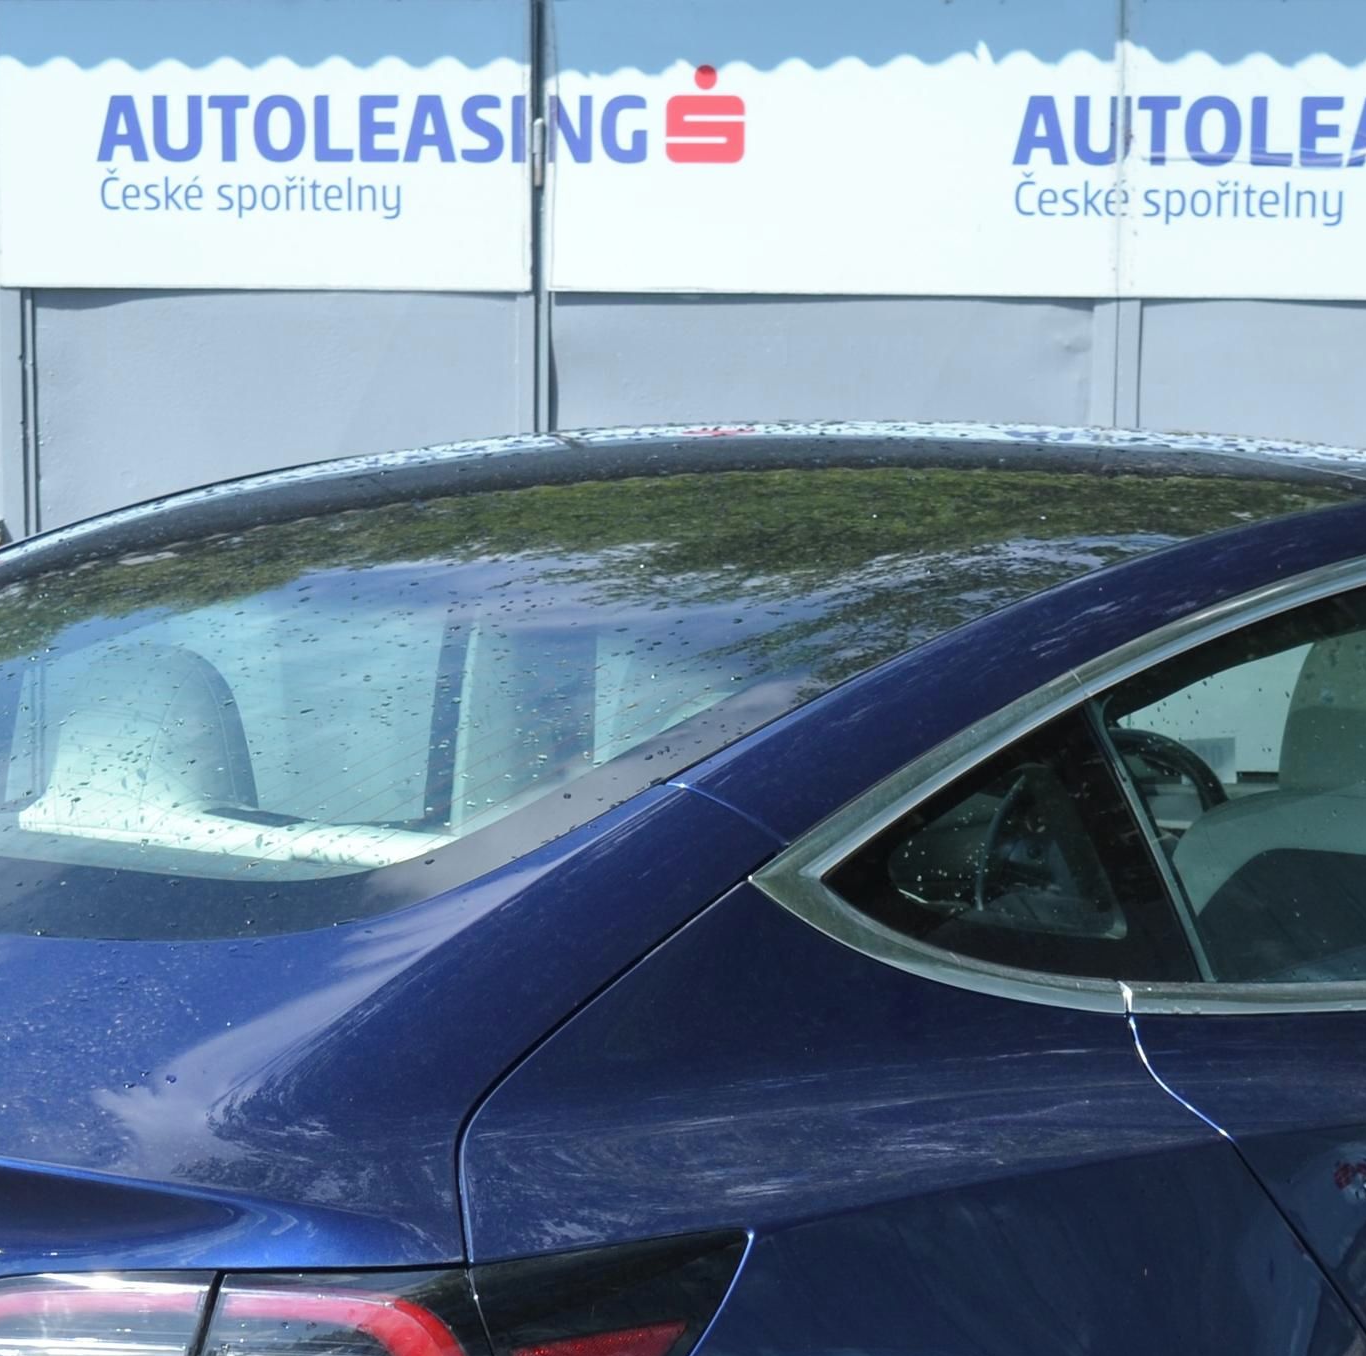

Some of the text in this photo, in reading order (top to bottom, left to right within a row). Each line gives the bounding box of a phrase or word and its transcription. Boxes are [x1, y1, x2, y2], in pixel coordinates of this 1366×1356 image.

[96, 94, 648, 164] AUTOLEASING
[100, 168, 402, 220] České spořitelny
[1014, 172, 1345, 226] České spořitelny
